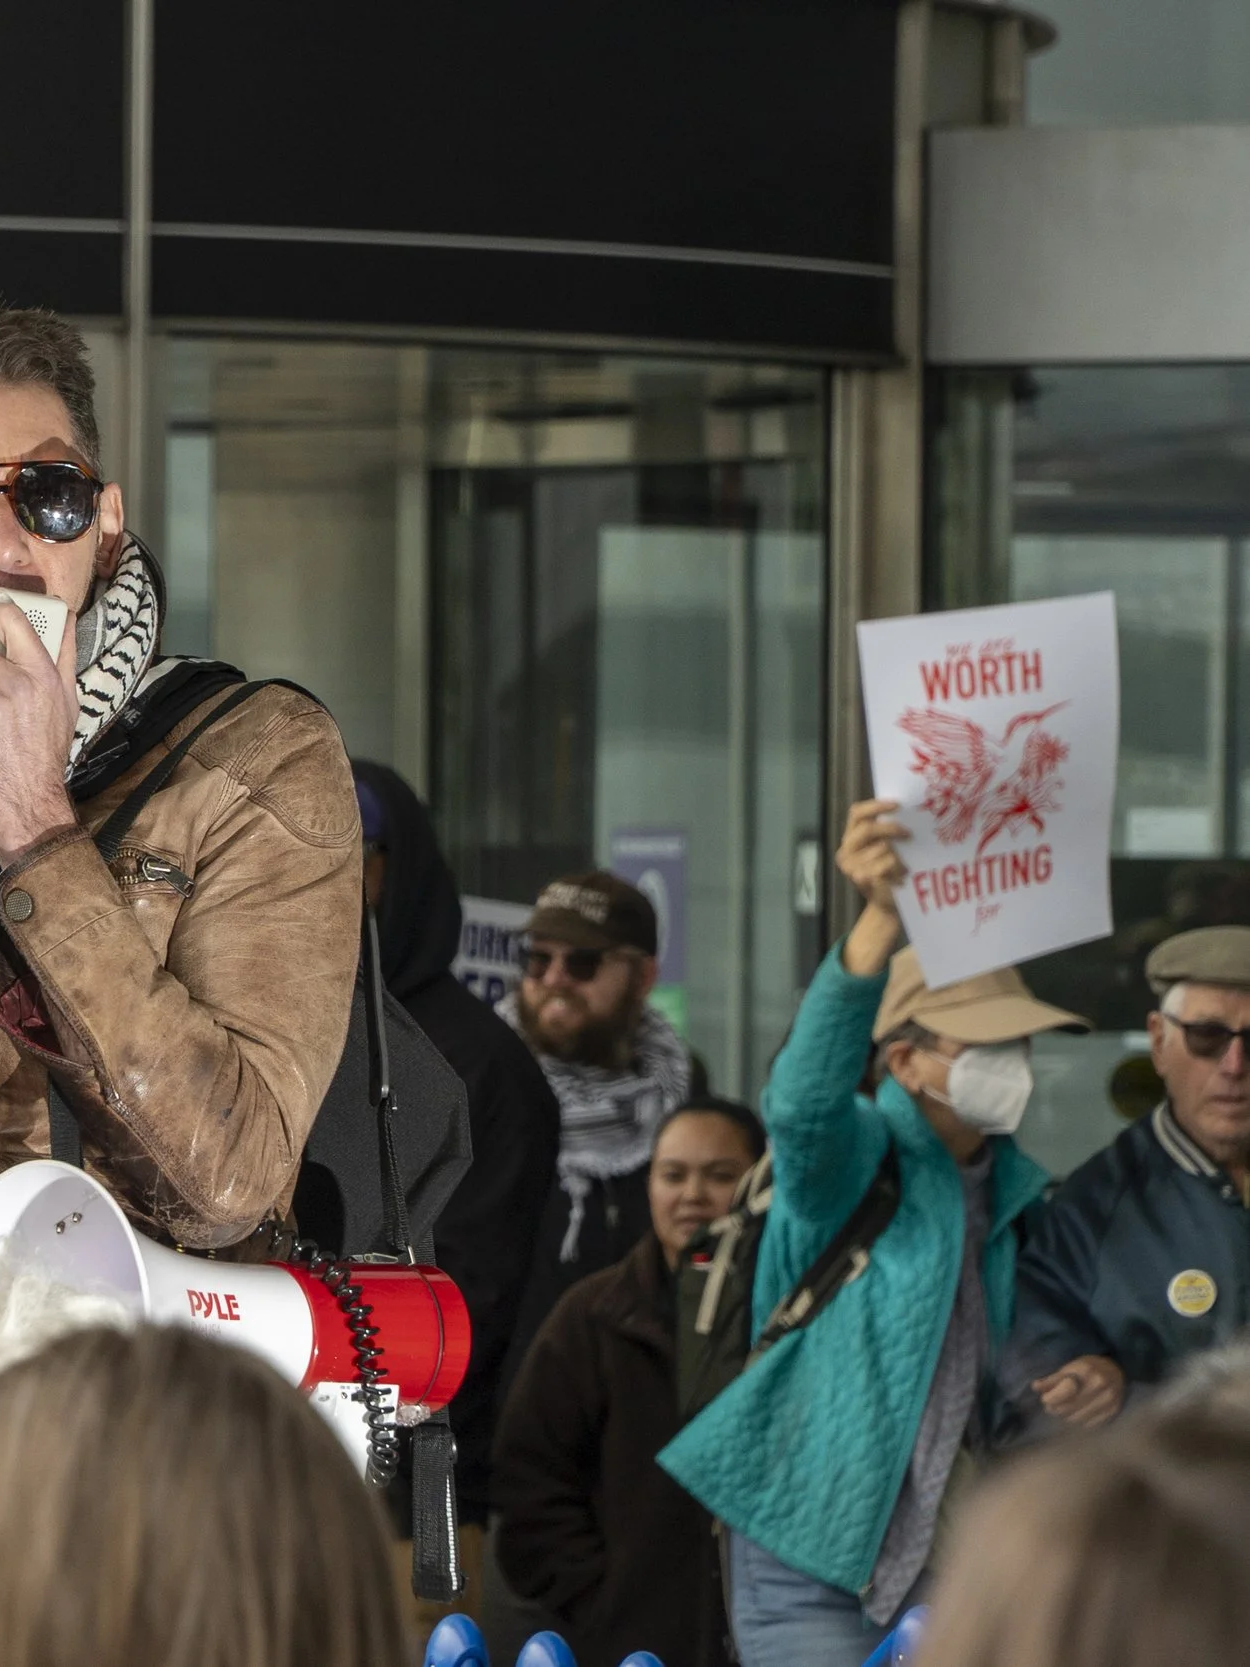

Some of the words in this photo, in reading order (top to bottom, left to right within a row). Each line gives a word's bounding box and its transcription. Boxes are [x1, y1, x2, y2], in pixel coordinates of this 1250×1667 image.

[919, 649, 1043, 702] WORTH
[912, 843, 1053, 914] FIGHTING
[187, 1289, 240, 1321] PYLE
